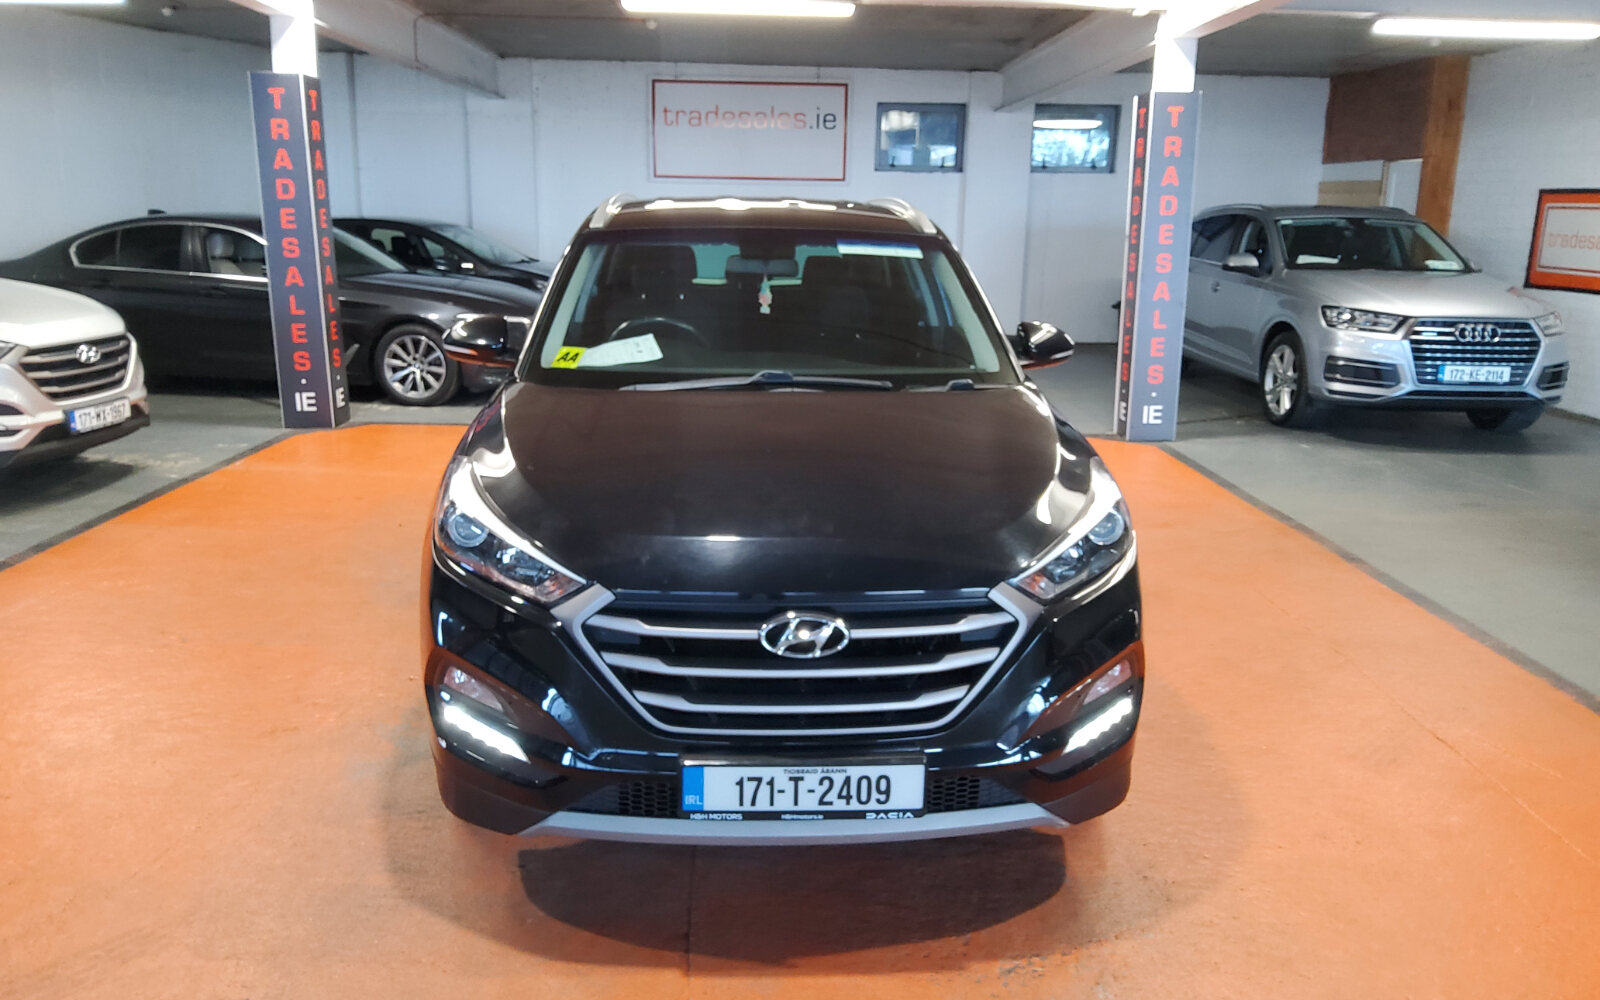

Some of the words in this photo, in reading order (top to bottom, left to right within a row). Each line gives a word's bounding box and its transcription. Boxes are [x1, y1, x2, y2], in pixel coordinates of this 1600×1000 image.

[662, 104, 837, 130] tradesales.ie
[557, 351, 580, 362] AA
[1450, 368, 1504, 381] 172-KE-2114
[735, 775, 892, 807] 171-T-2409
[685, 795, 703, 805] IRL
